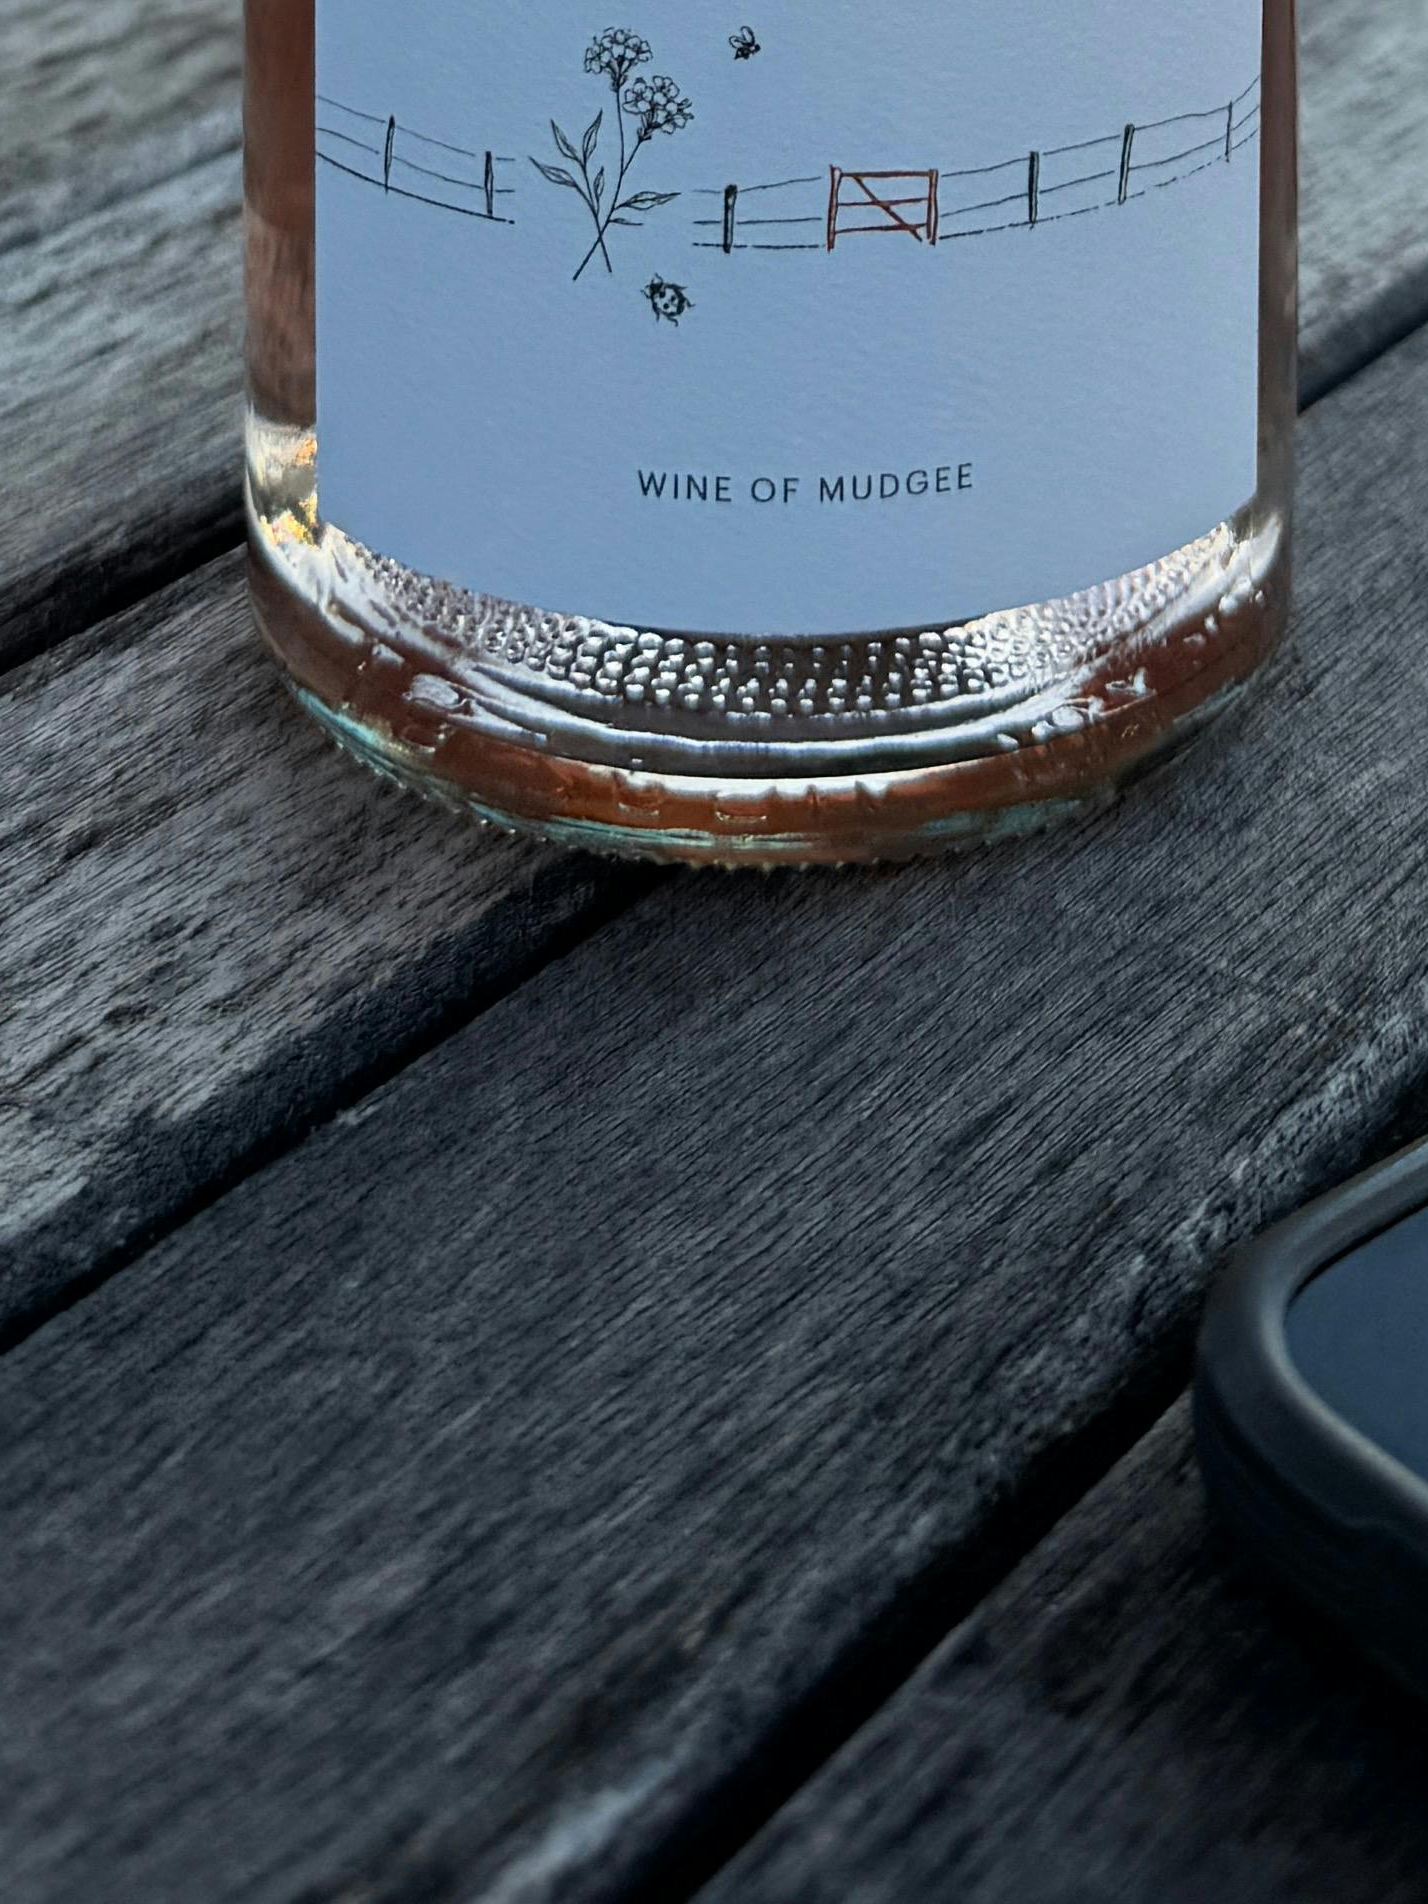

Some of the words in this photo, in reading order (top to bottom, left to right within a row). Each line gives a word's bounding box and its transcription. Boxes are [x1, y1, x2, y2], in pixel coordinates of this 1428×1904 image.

[637, 469, 732, 503] WINE
[750, 477, 800, 504] OF
[819, 462, 973, 505] MUDGEE
